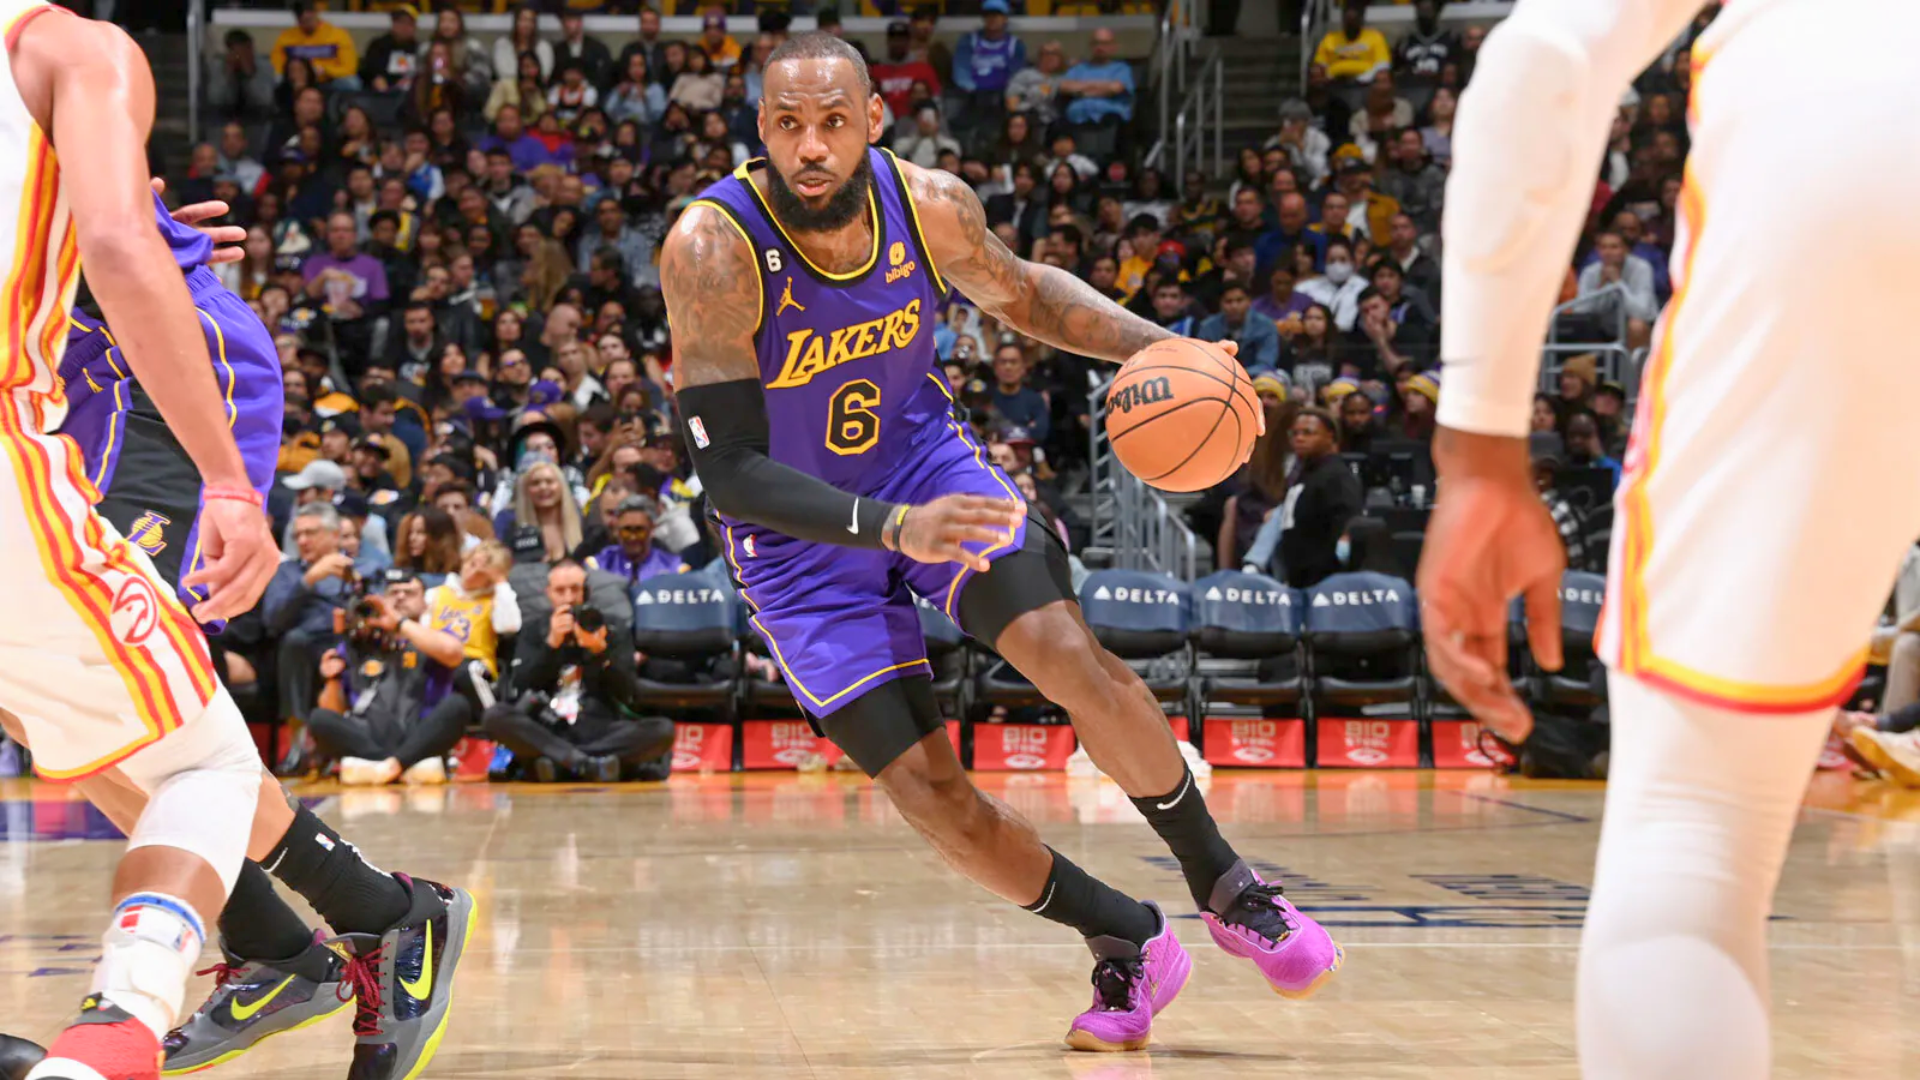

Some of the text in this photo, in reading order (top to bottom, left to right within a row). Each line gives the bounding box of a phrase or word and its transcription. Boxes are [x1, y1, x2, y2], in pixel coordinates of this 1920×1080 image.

[766, 249, 782, 272] 6
[885, 261, 915, 283] bibigo
[765, 298, 921, 389] LAKERS
[1105, 376, 1175, 418] Wilso
[825, 378, 881, 456] 6
[657, 589, 725, 605] DELTA
[1114, 586, 1180, 606] DELTA
[1226, 587, 1292, 606] DELTA
[1332, 589, 1400, 606] DELTA
[1565, 587, 1604, 605] DEL
[676, 725, 704, 742] IO
[771, 723, 815, 739] BIO
[1003, 726, 1047, 744] BIO
[1231, 720, 1276, 737] BIO
[1344, 720, 1390, 738] BIO
